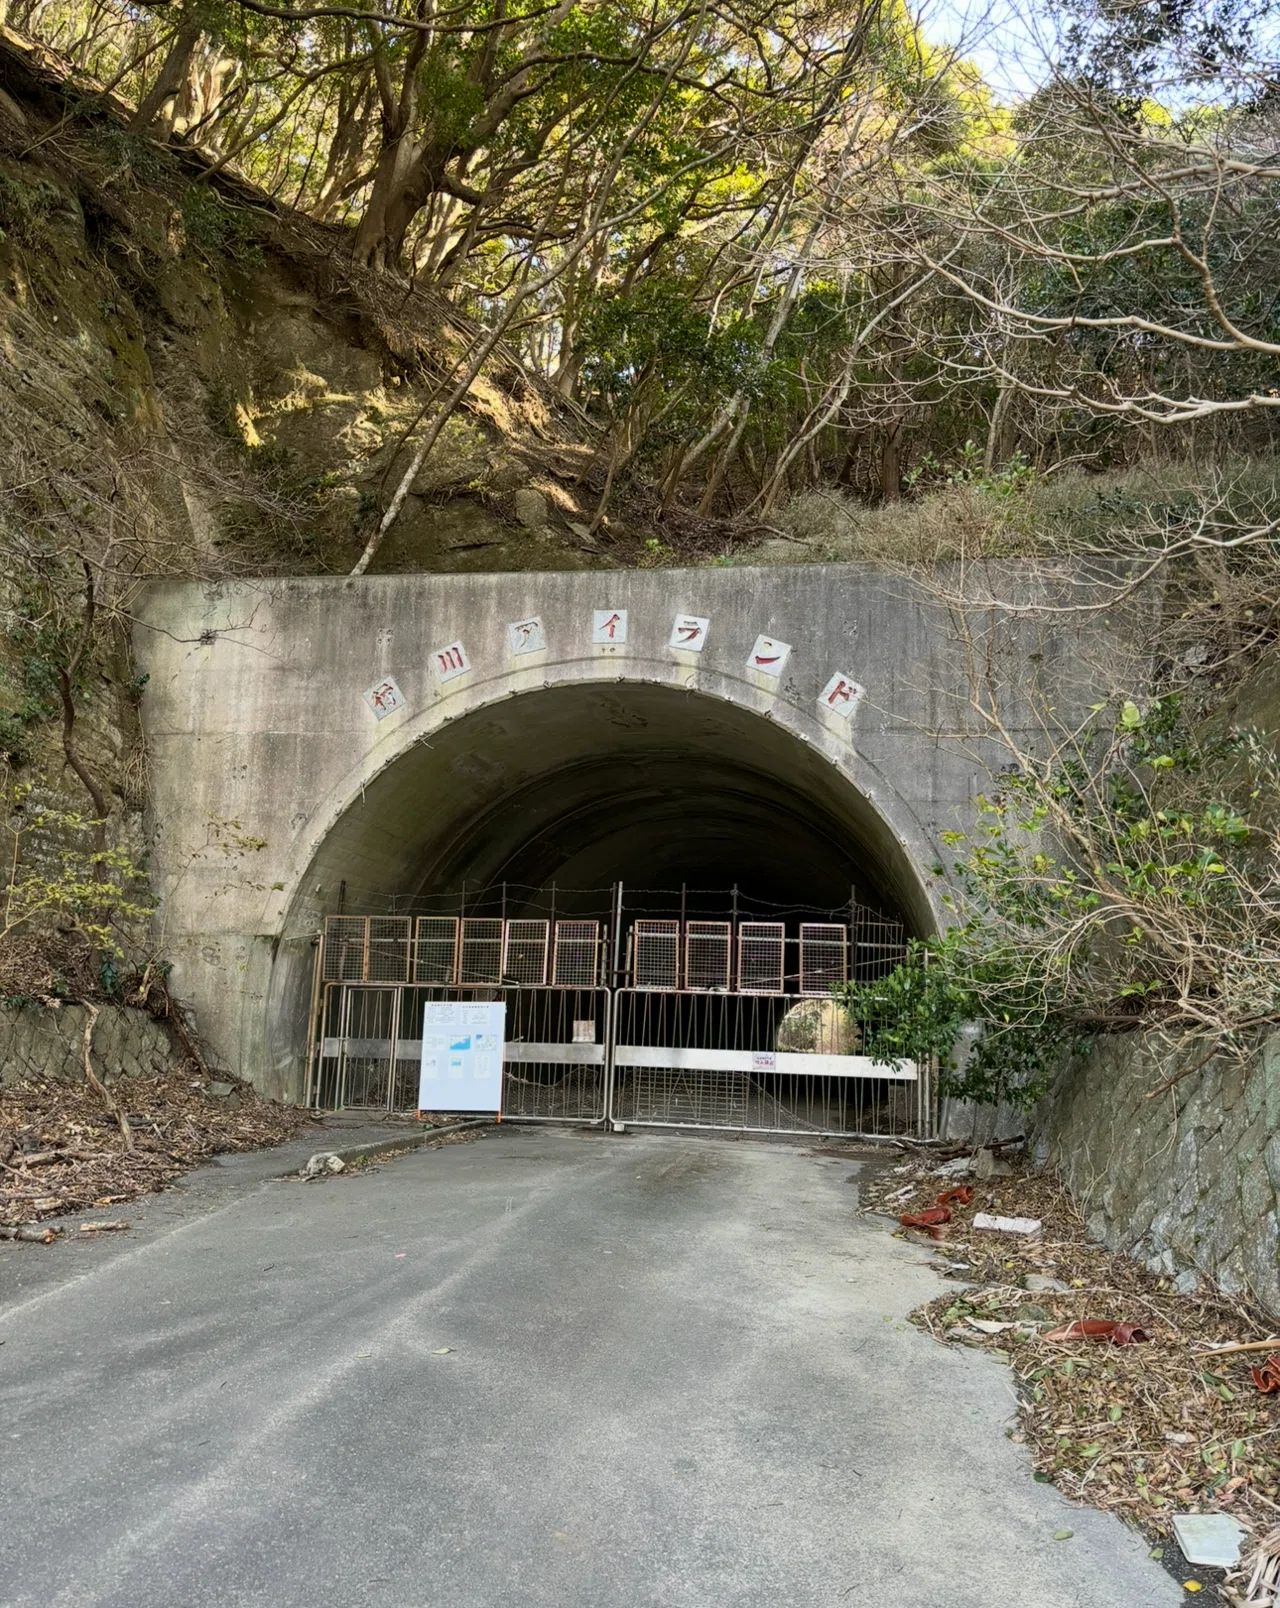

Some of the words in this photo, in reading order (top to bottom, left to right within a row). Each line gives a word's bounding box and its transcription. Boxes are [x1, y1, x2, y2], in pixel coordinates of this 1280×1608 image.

[372, 613, 857, 711] 行川アイランド
